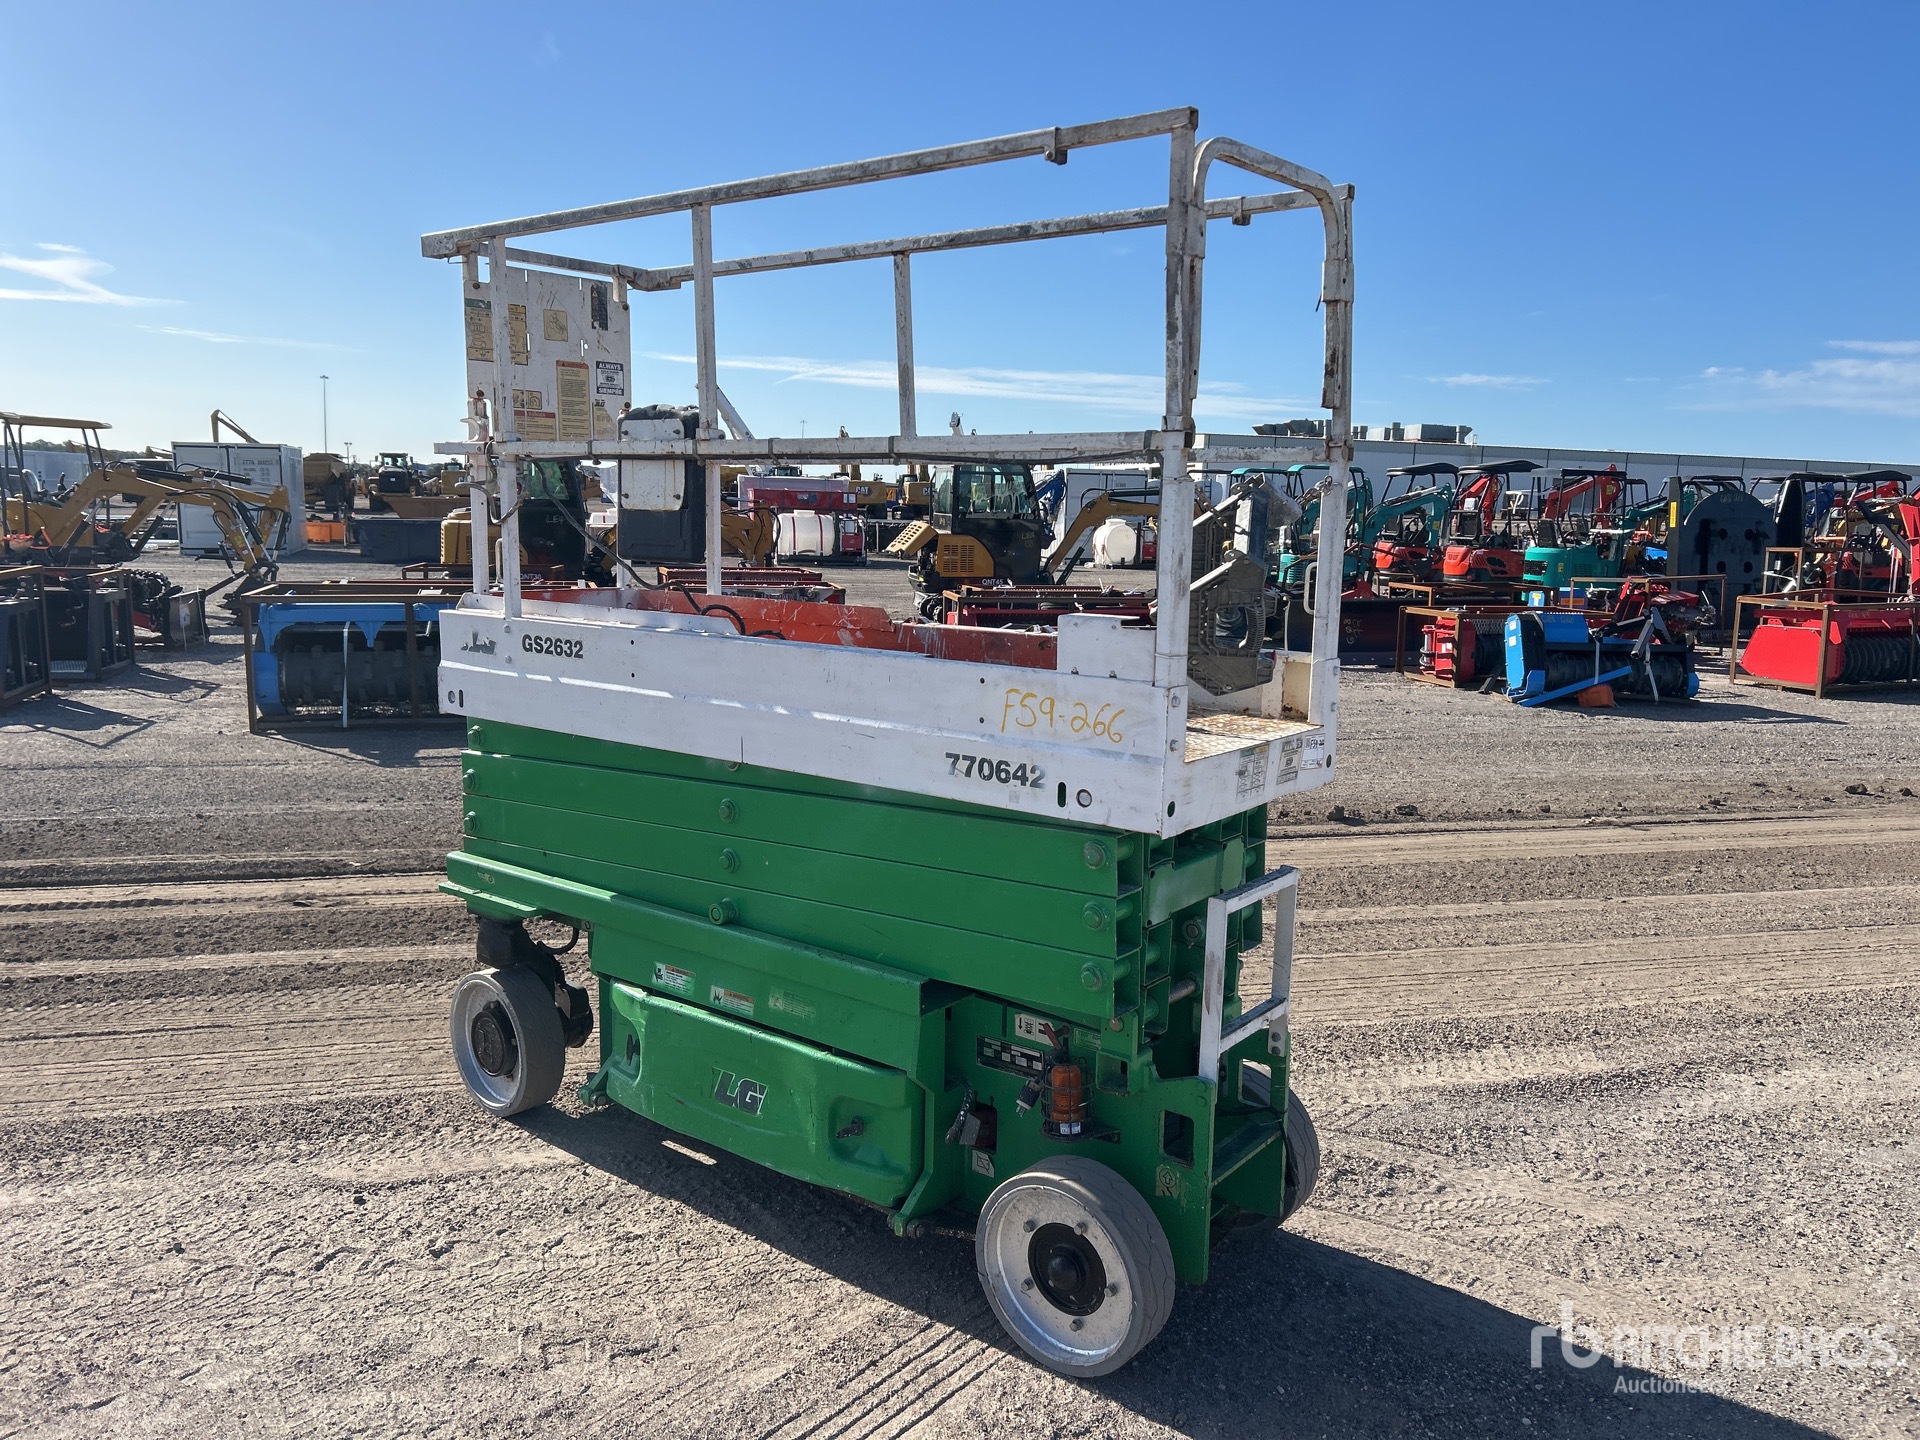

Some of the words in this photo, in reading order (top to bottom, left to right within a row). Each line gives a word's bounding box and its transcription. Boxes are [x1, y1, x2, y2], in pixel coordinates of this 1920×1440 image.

[598, 362, 621, 371] ALWAYS
[855, 486, 869, 495] CAT
[522, 634, 584, 659] GS2632
[1001, 688, 1125, 743] F59-266
[945, 751, 1047, 790] 770642
[713, 1069, 769, 1117] LG
